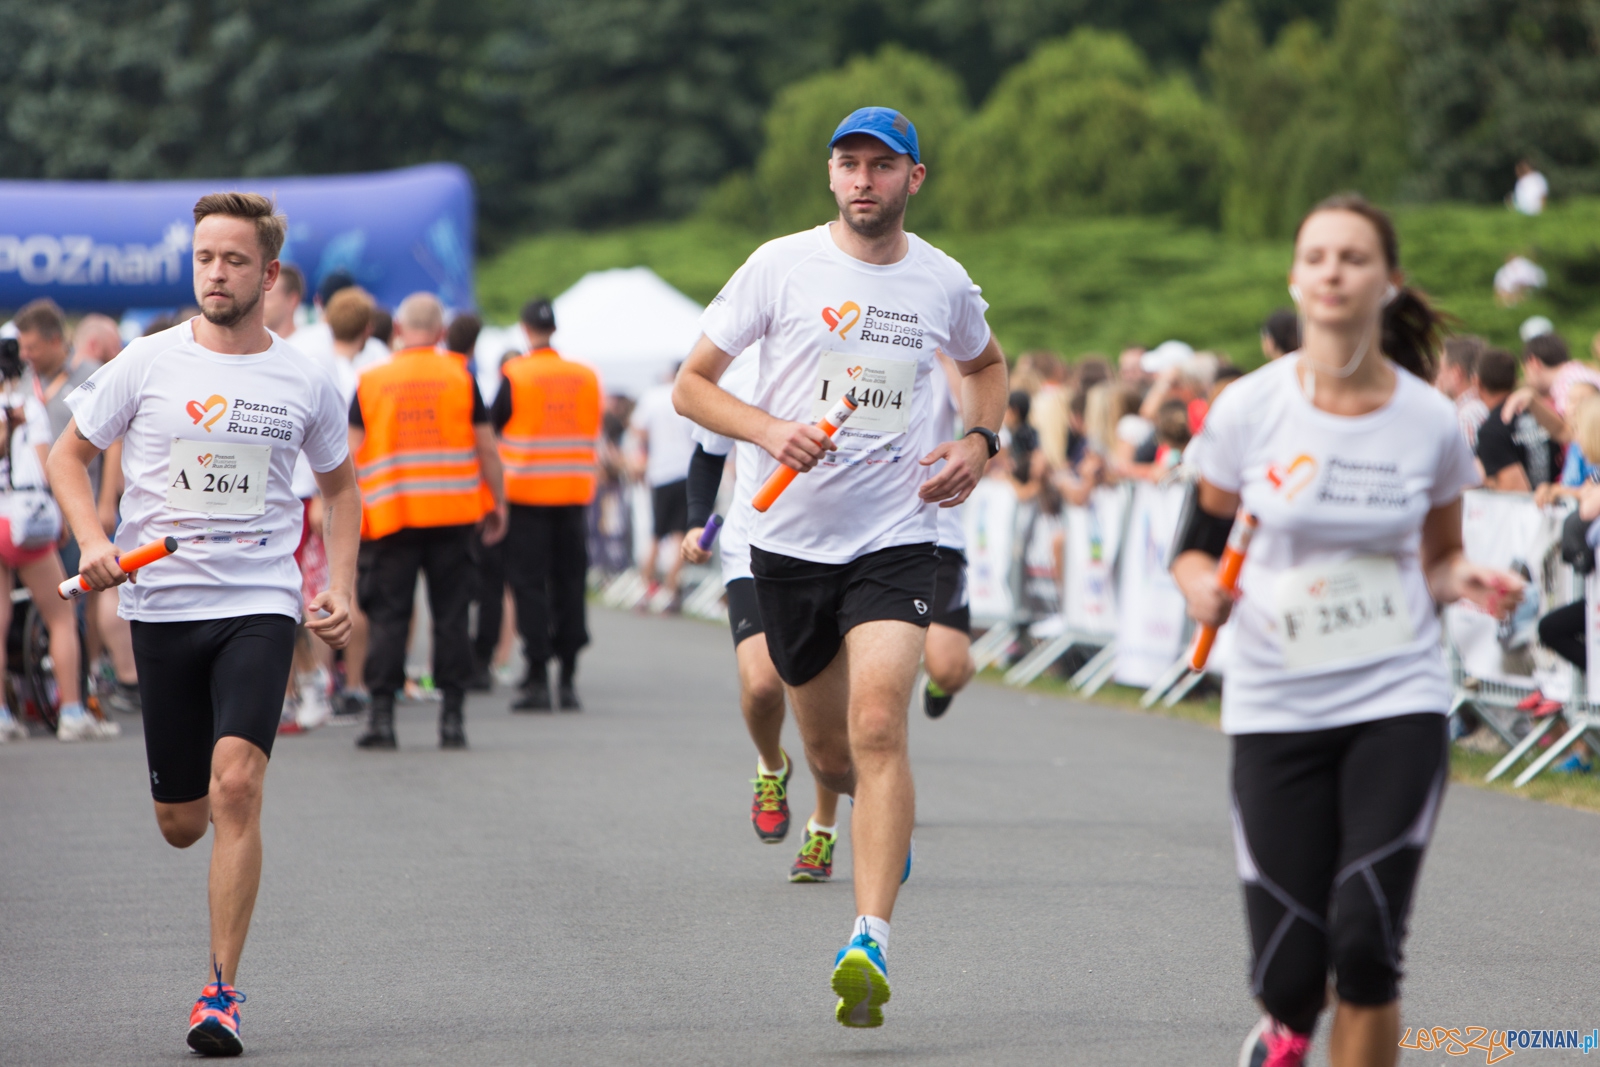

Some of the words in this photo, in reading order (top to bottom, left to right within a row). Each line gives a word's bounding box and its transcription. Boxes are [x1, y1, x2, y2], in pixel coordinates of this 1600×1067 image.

[866, 305, 919, 324] Poznań
[863, 316, 924, 338] Business
[859, 329, 889, 344] Run
[892, 334, 923, 350] 2016
[233, 398, 288, 416] Poznań
[230, 410, 293, 430] Business
[226, 421, 258, 436] Run
[261, 426, 293, 441] 2016
[171, 468, 193, 491] A
[202, 473, 250, 494] 26/4
